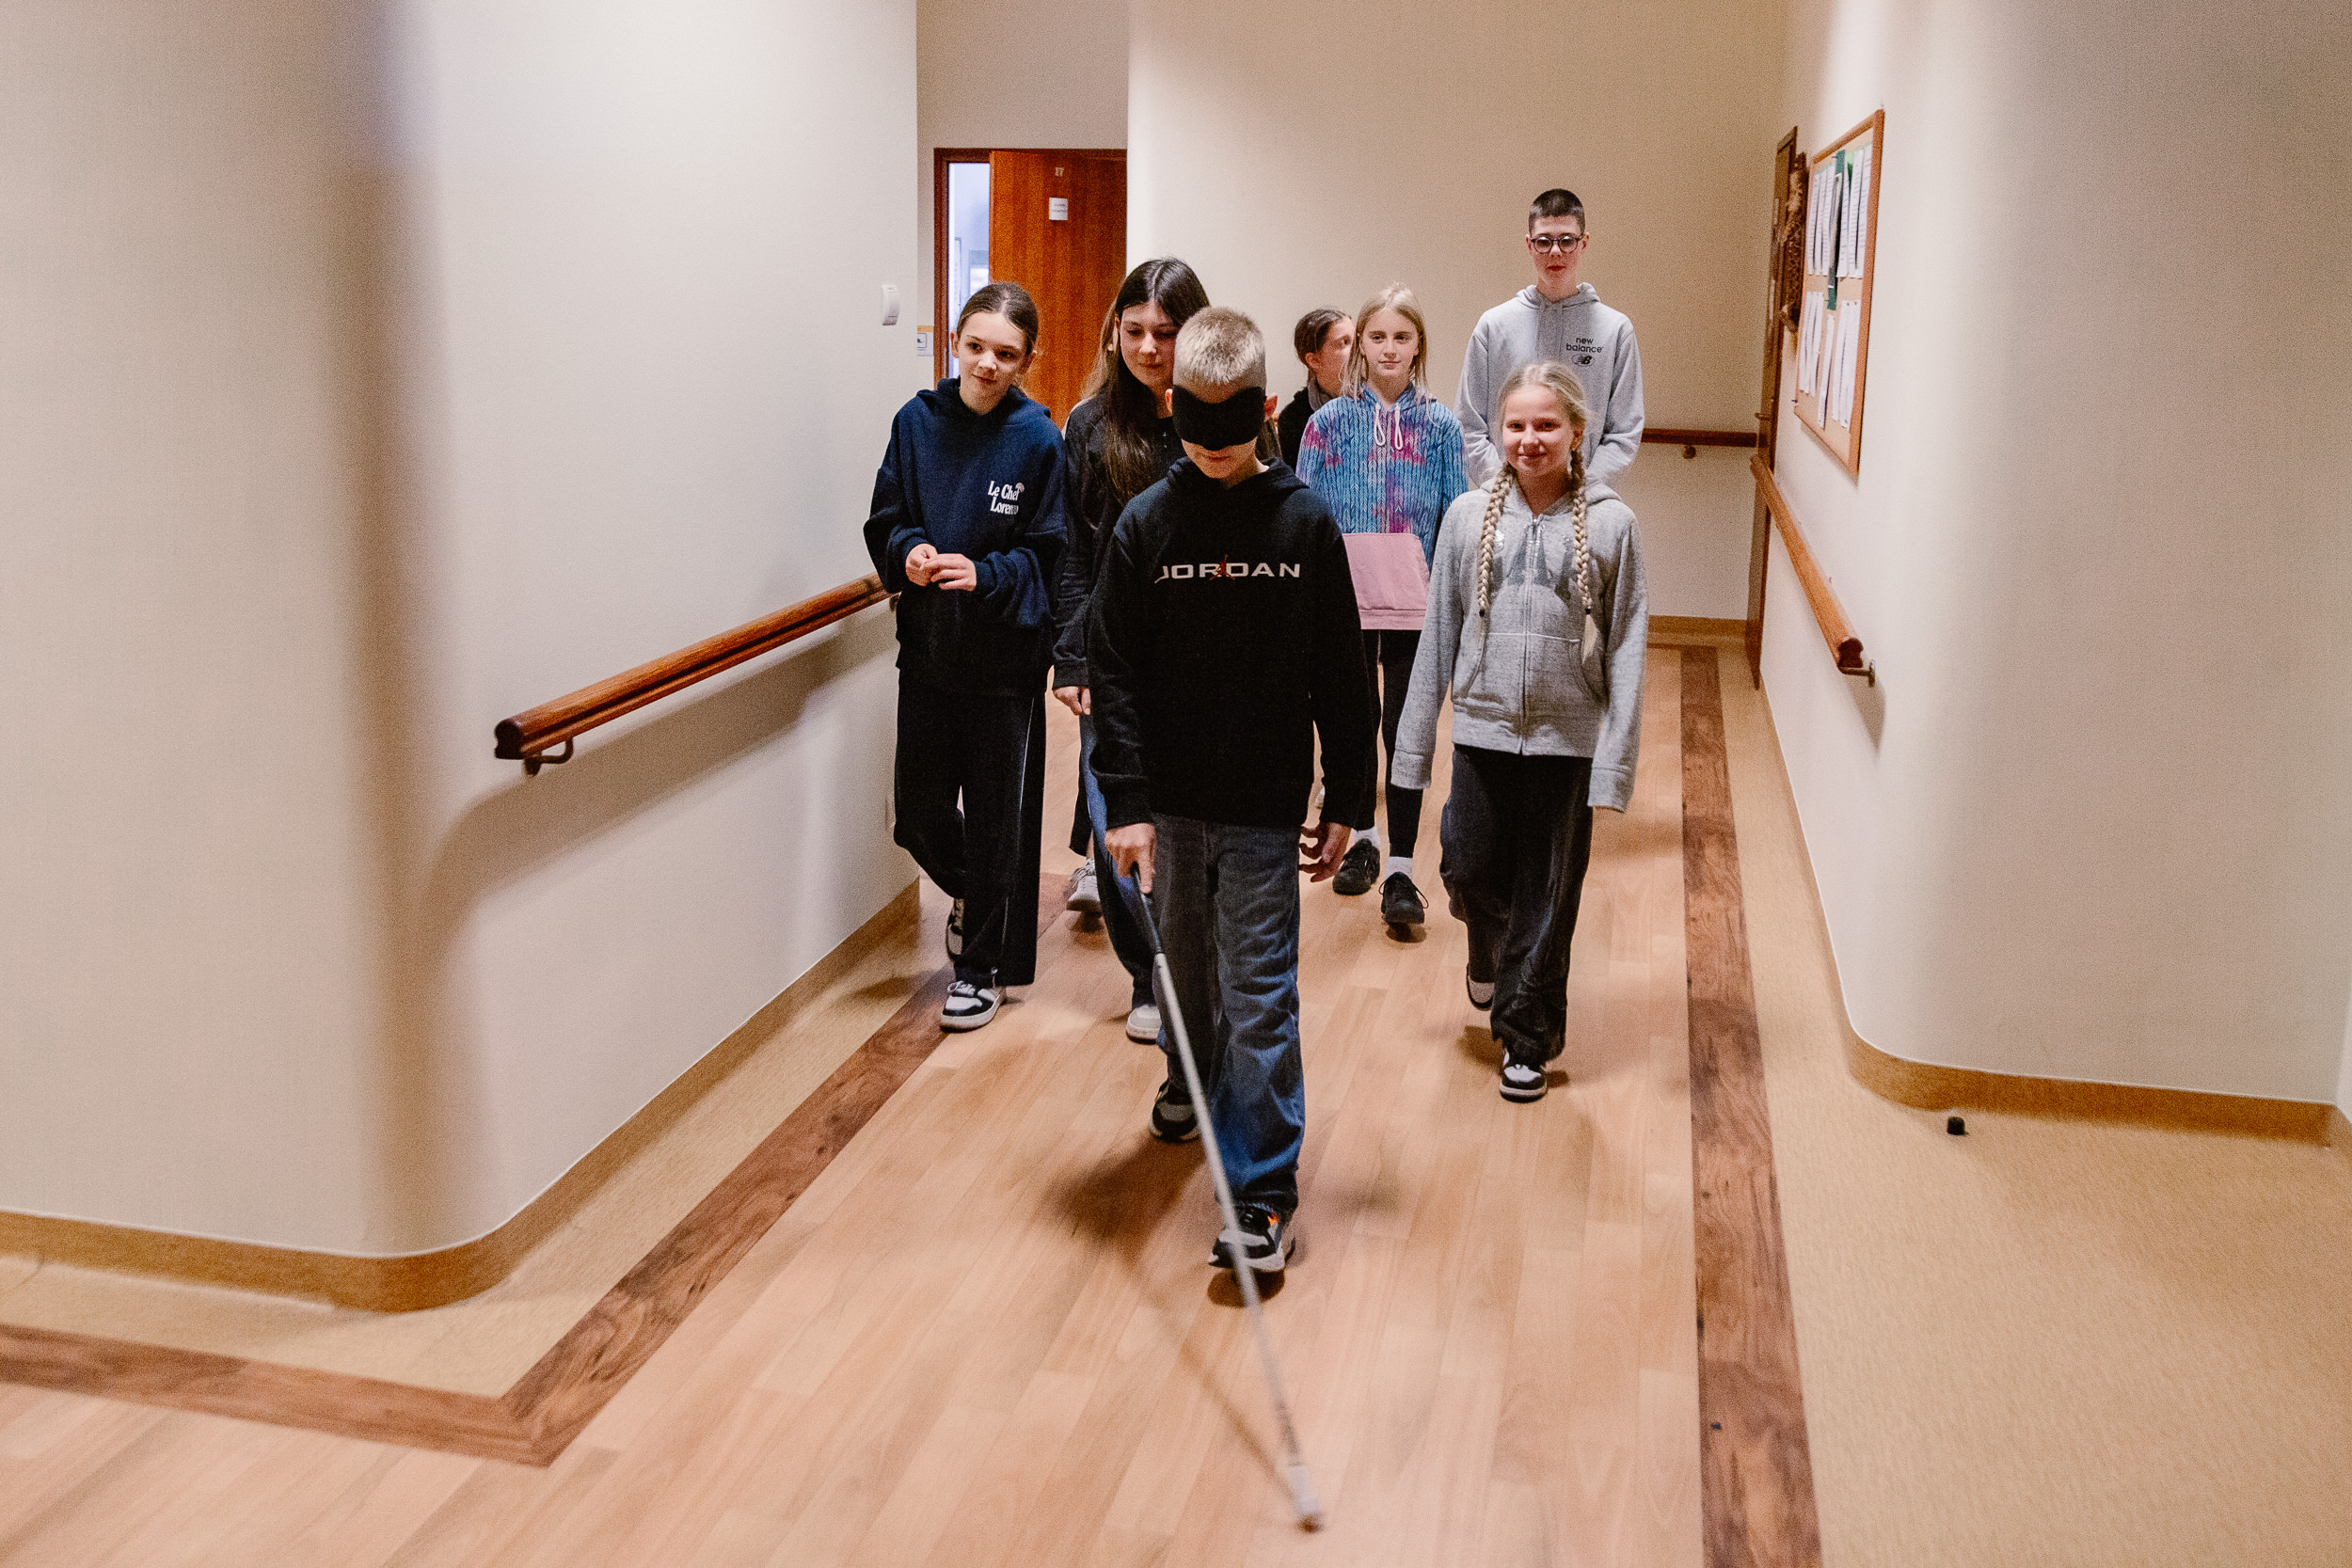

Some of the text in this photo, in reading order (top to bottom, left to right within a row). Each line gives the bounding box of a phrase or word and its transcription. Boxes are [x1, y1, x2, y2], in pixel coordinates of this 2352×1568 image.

[1565, 342, 1603, 354] balance
[1575, 337, 1594, 345] new
[987, 481, 1021, 501] Le Chef
[1153, 562, 1301, 584] JORDAN
